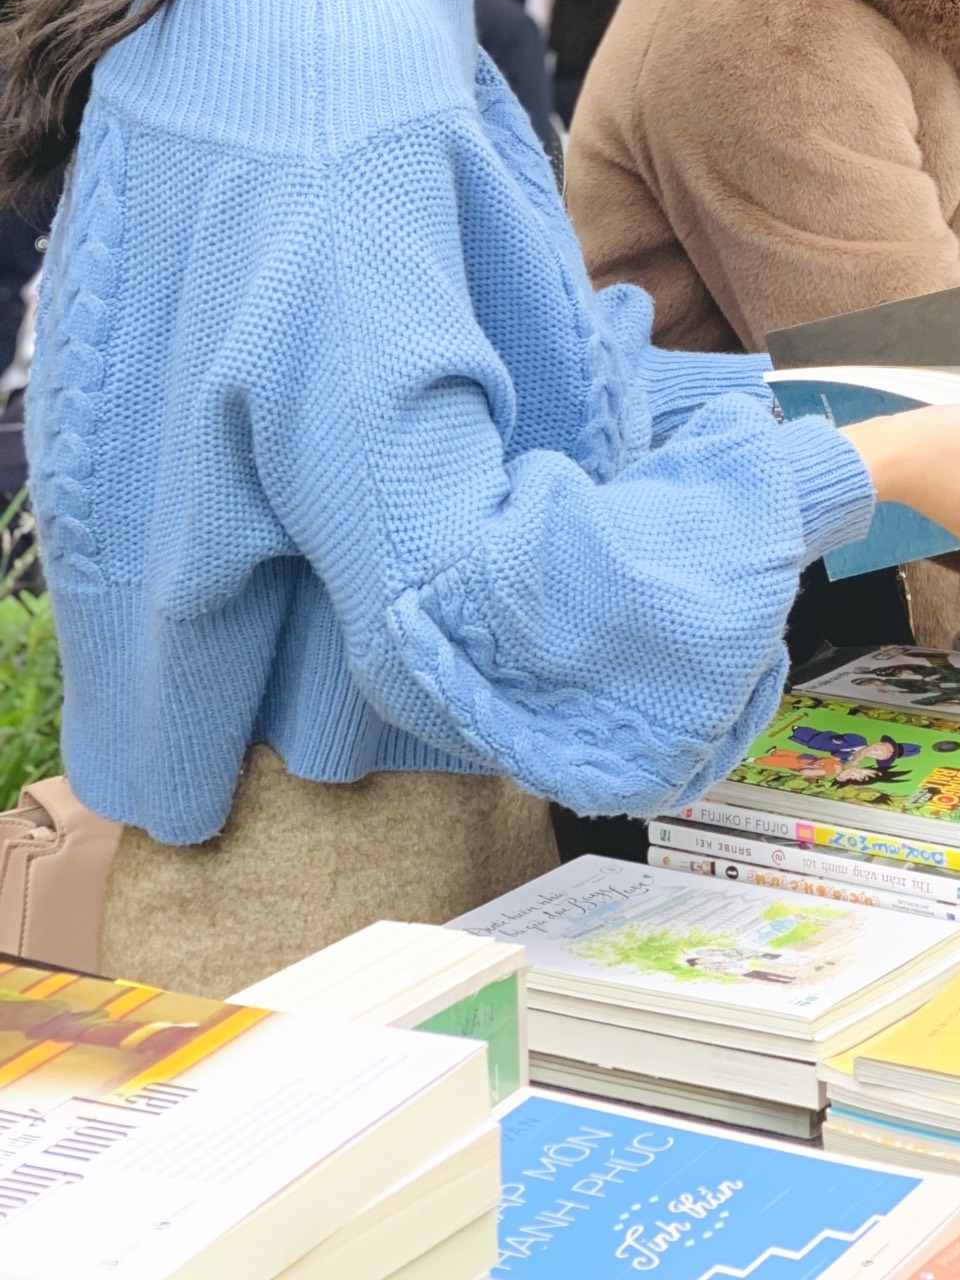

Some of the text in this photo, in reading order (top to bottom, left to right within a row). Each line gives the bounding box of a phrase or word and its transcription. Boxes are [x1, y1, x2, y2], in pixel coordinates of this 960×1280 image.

[695, 838, 752, 857] SANBE KEI
[701, 808, 789, 836] FUJIKO F FUJIO
[521, 1125, 613, 1182] MÔN
[493, 1132, 675, 1271] HẠNH PHÚC
[614, 1219, 692, 1271] Tinh
